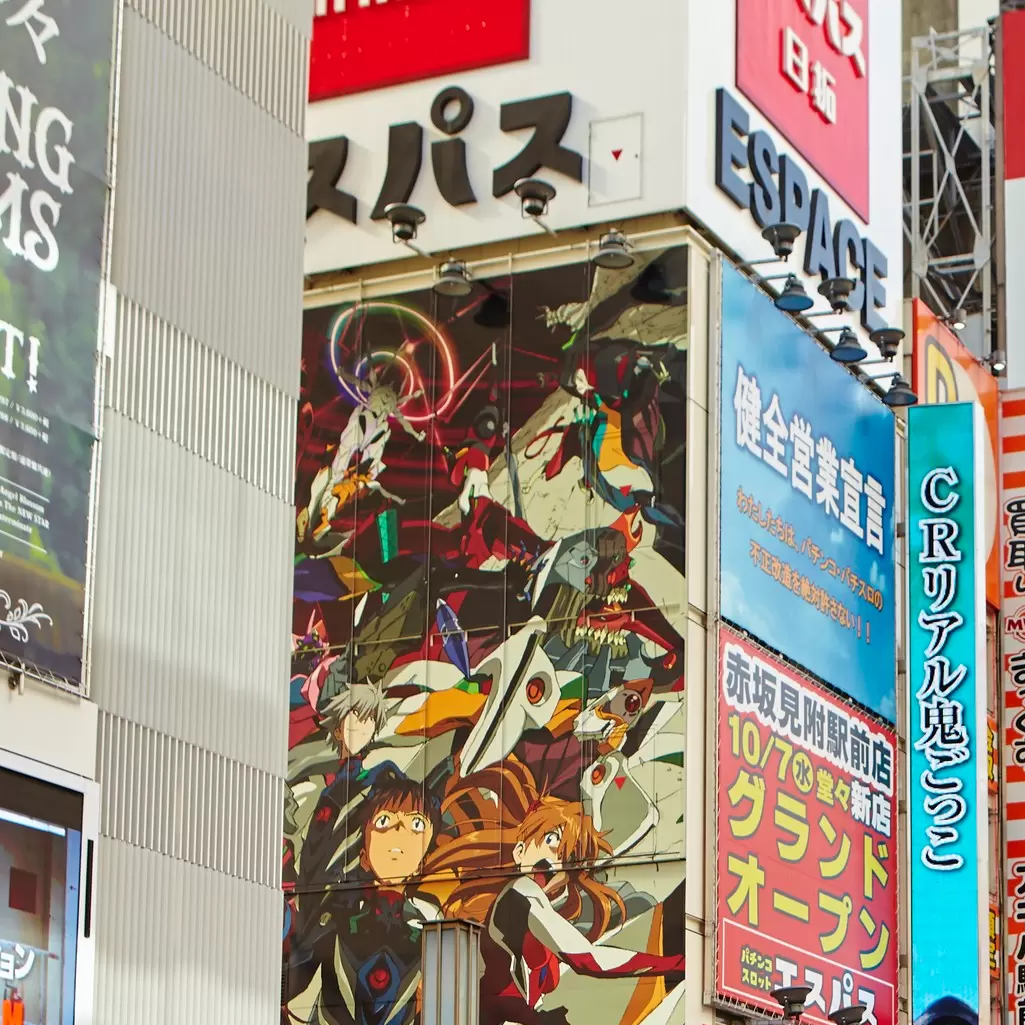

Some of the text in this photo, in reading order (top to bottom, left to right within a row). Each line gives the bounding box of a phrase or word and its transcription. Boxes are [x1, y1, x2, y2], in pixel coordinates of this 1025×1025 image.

[784, 25, 837, 125] 日拓
[716, 87, 889, 334] ESPACE
[733, 365, 886, 555] 健全営業宣言
[726, 648, 893, 789] 赤坂見附駅前店
[915, 465, 969, 872] CRリアル鬼ごっこ
[727, 769, 890, 900] グランド
[727, 852, 891, 972] オープン
[740, 944, 773, 975] パチンコ
[742, 966, 772, 992] スロット
